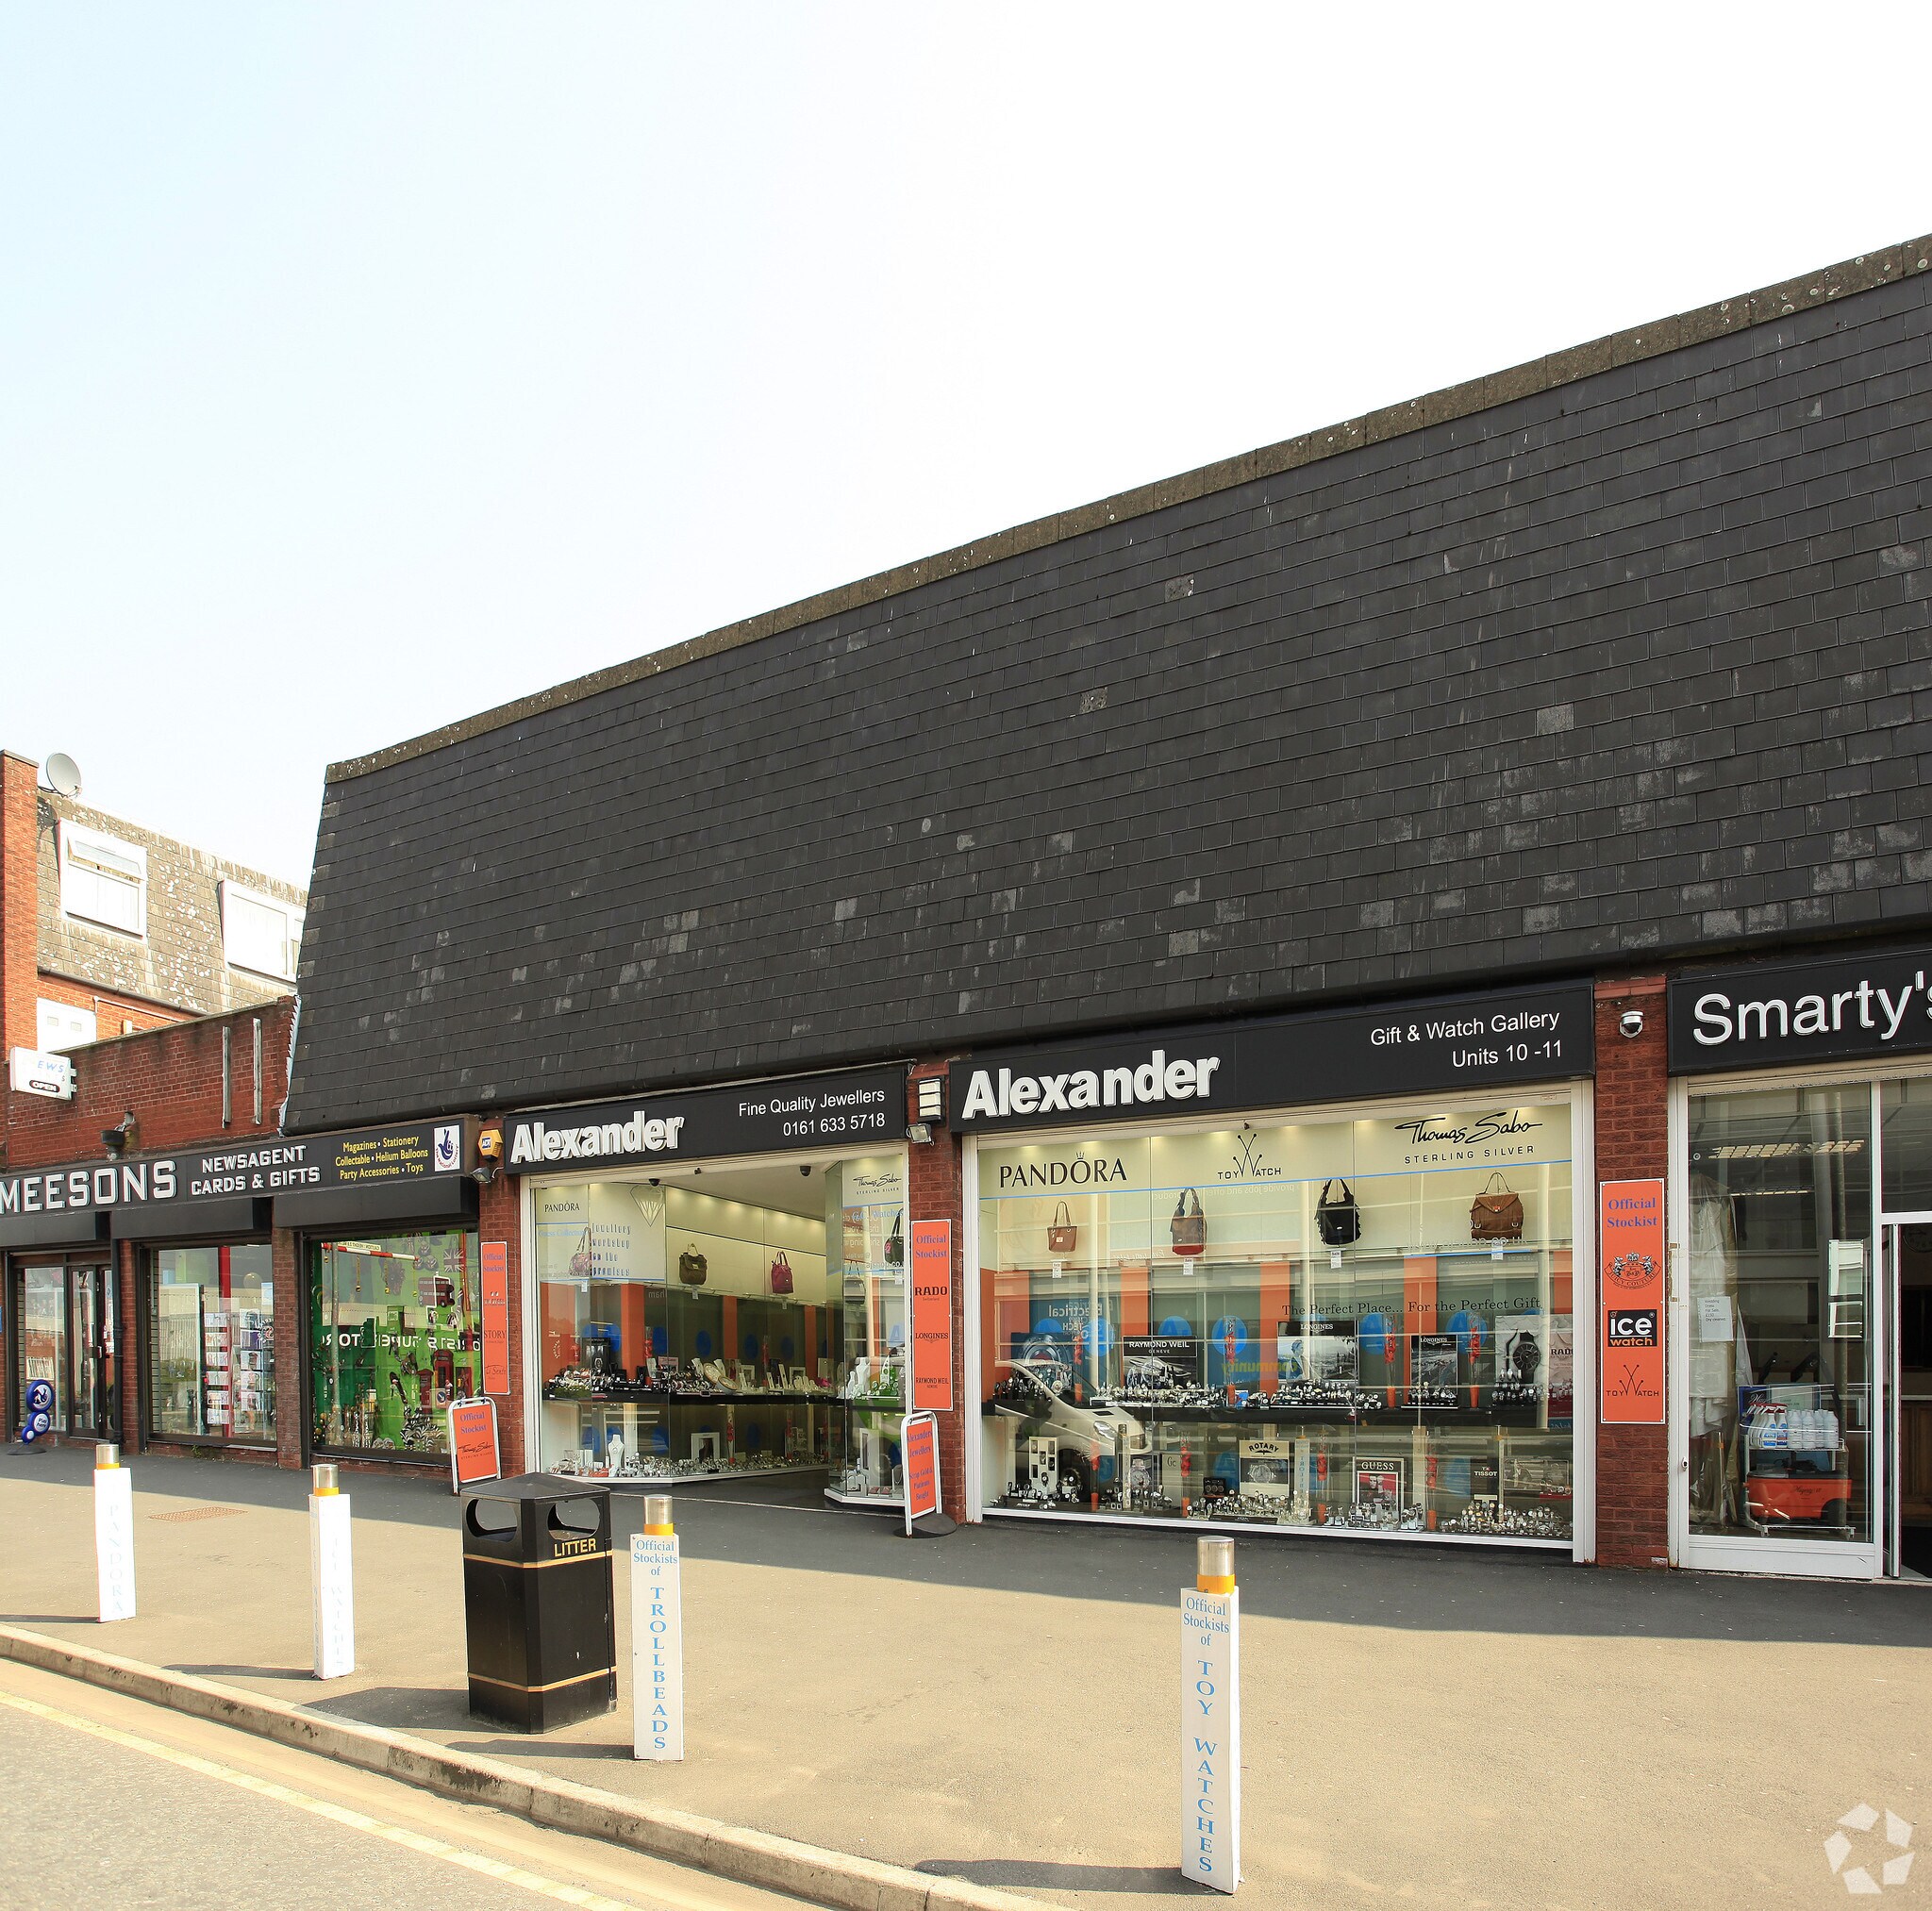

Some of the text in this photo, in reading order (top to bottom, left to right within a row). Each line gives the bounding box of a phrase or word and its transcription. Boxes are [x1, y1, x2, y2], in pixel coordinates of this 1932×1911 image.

[1693, 970, 1932, 1046] Smarty'
[1371, 1011, 1560, 1046] Gift & Watch Gallery
[1451, 1047, 1499, 1068] Units
[1506, 1043, 1528, 1062] 10
[32, 1081, 58, 1092] OPEN
[961, 1049, 1221, 1121] Alexander
[738, 1088, 886, 1117] Fine Quality Jewellers
[782, 1112, 886, 1138] 0161 633 5718
[1394, 1110, 1543, 1145] Thomas Sabo
[342, 1135, 419, 1155] Magazines Stationery
[510, 1109, 685, 1164] Alexander
[202, 1145, 307, 1174] NEWSAGENT
[335, 1147, 428, 1167] Collectable Helium Balloons
[1405, 1144, 1535, 1164] STERLING SILVER
[191, 1166, 321, 1196] CARDS & GIFTS
[340, 1162, 424, 1181] Party Accessories Toys
[0, 1159, 177, 1215] MEESONS
[1607, 1197, 1657, 1210] Official
[1607, 1215, 1657, 1228] Stockist
[916, 1234, 946, 1244] Official
[915, 1249, 948, 1259] Stockist
[915, 1286, 948, 1297] RADO
[1282, 1304, 1306, 1316] The
[1309, 1303, 1354, 1315] Perfect
[1407, 1301, 1431, 1313] For
[1436, 1300, 1457, 1312] the
[1461, 1298, 1509, 1311] Perfect
[484, 1329, 506, 1339] STORY
[1610, 1318, 1653, 1336] ice
[1169, 1339, 1191, 1348] WEIL
[1609, 1338, 1653, 1347] watch
[915, 1376, 949, 1386] RAYMOND WEIL
[459, 1411, 485, 1421] Official
[460, 1423, 487, 1435] Stockist
[1248, 1441, 1279, 1454] ROTARY
[1361, 1461, 1394, 1471] GUESS
[554, 1537, 596, 1557] LITTER
[636, 1539, 675, 1552] Official
[633, 1552, 678, 1564] Stockists
[650, 1566, 661, 1576] of
[1186, 1596, 1226, 1616] Official
[1183, 1612, 1230, 1634] Stockists
[1200, 1634, 1211, 1647] of
[649, 1587, 669, 1750] TROLLBEADS
[1195, 1659, 1216, 1717] TOY
[1192, 1737, 1218, 1873] WATCHES
